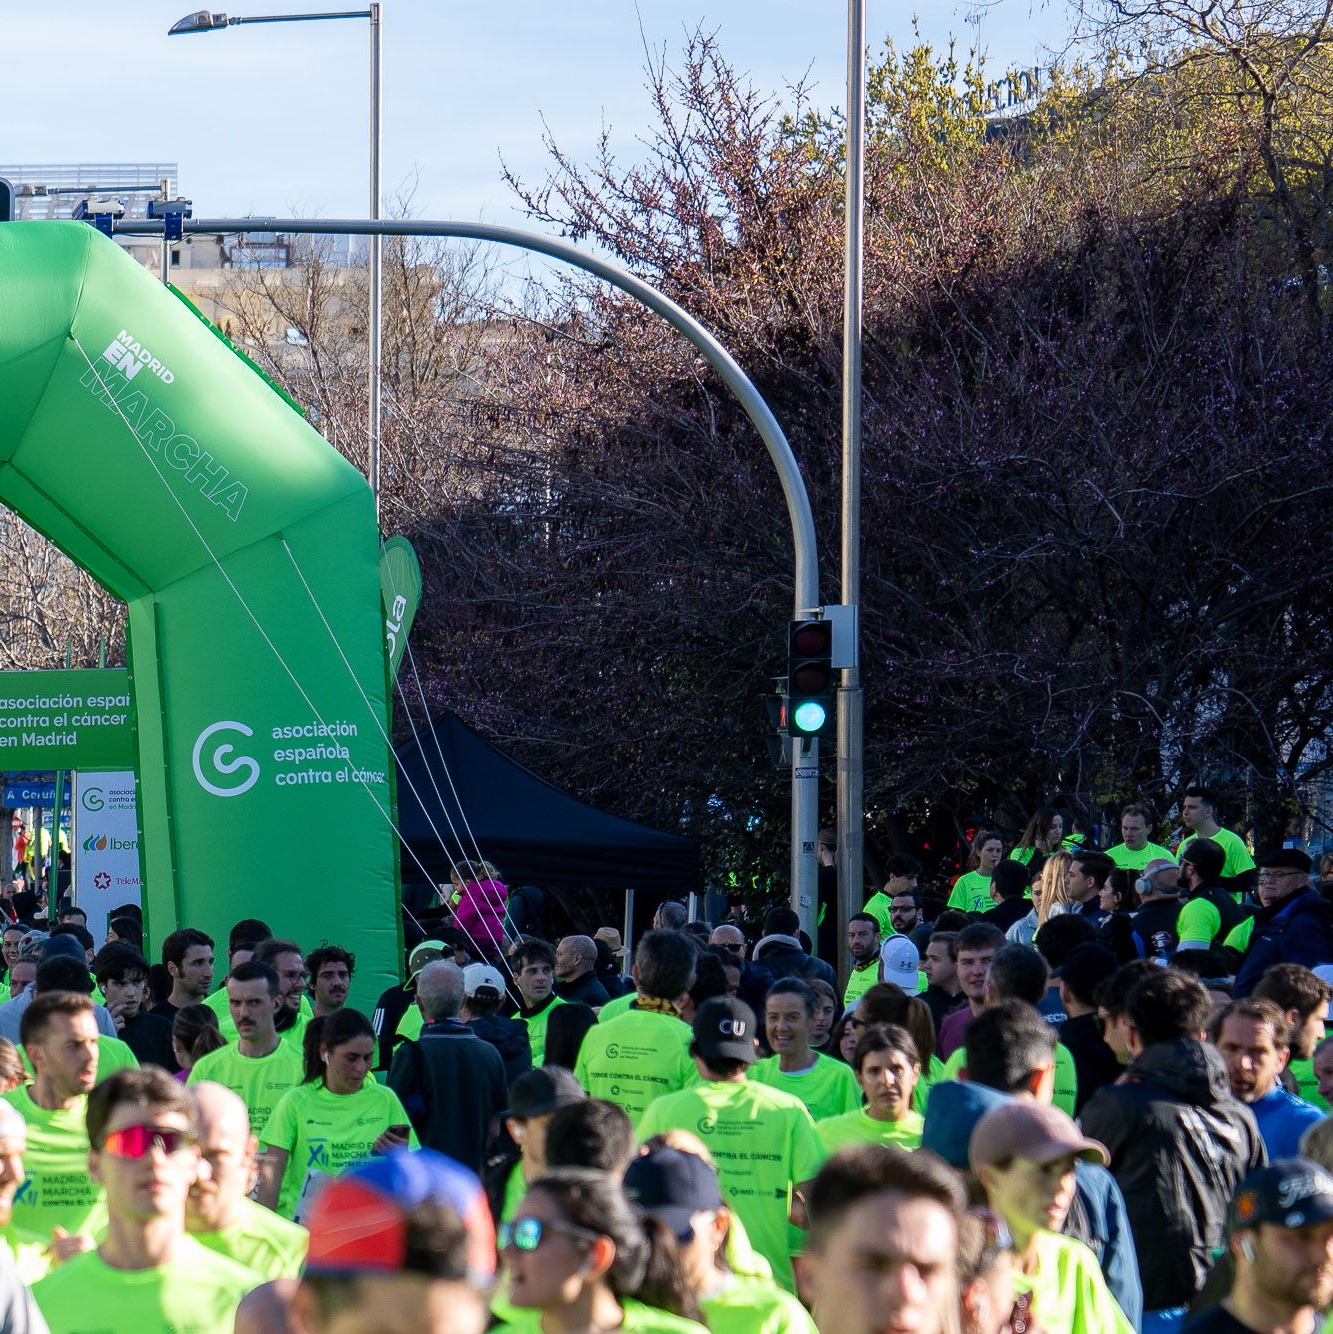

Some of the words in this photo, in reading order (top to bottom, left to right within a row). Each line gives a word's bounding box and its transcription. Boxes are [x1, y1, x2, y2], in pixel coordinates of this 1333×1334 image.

[102, 339, 144, 381] EN
[116, 329, 175, 384] MADRID
[79, 356, 248, 521] MARCHA
[53, 712, 67, 727] el
[71, 712, 127, 727] cáncer
[22, 731, 77, 747] Madrid
[271, 720, 358, 739] asociación
[274, 743, 350, 764] española
[275, 770, 331, 786] contra
[335, 767, 349, 783] el
[332, 1142, 365, 1150] MADRID
